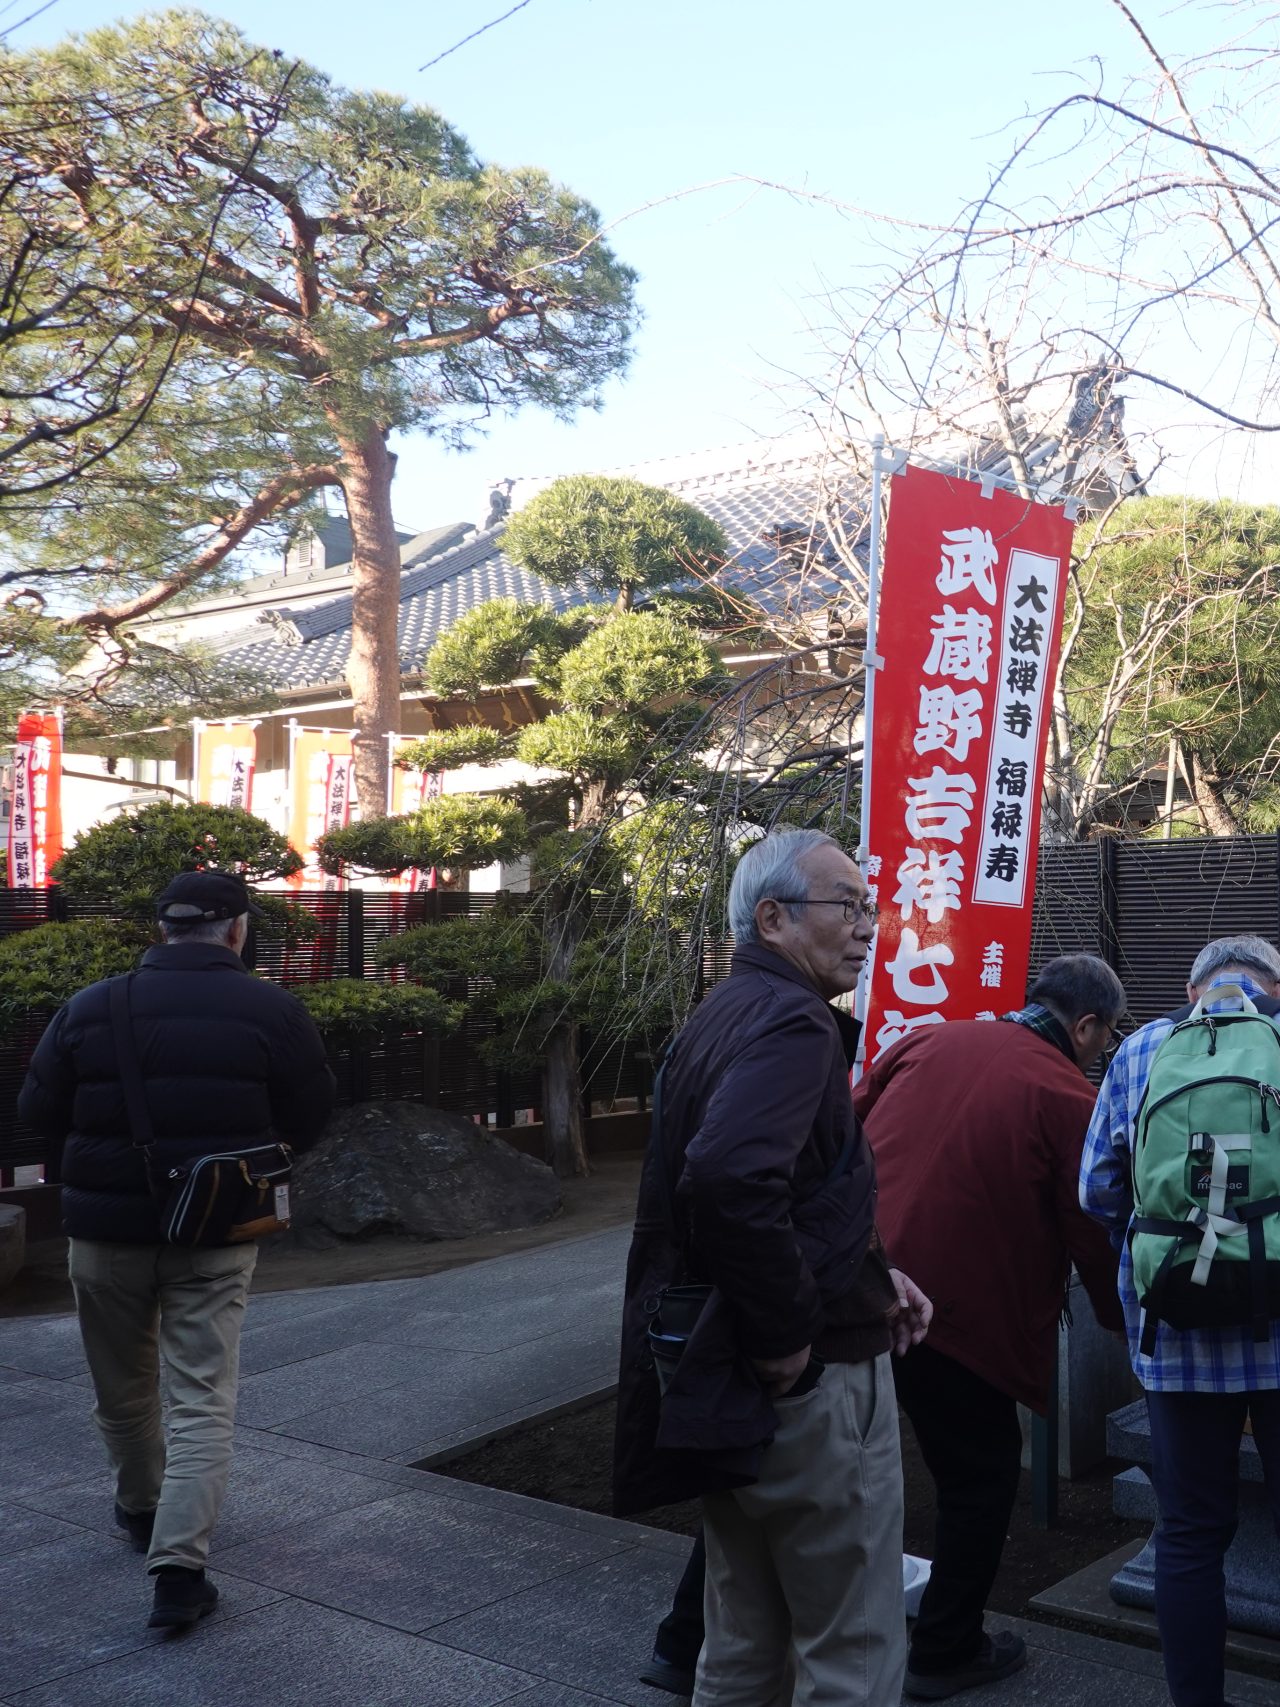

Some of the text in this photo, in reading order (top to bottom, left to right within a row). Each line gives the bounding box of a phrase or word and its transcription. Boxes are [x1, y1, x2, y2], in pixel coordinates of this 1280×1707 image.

[985, 575, 1048, 883] 大法禅寺 福禄寿
[980, 940, 1005, 988] 主催
